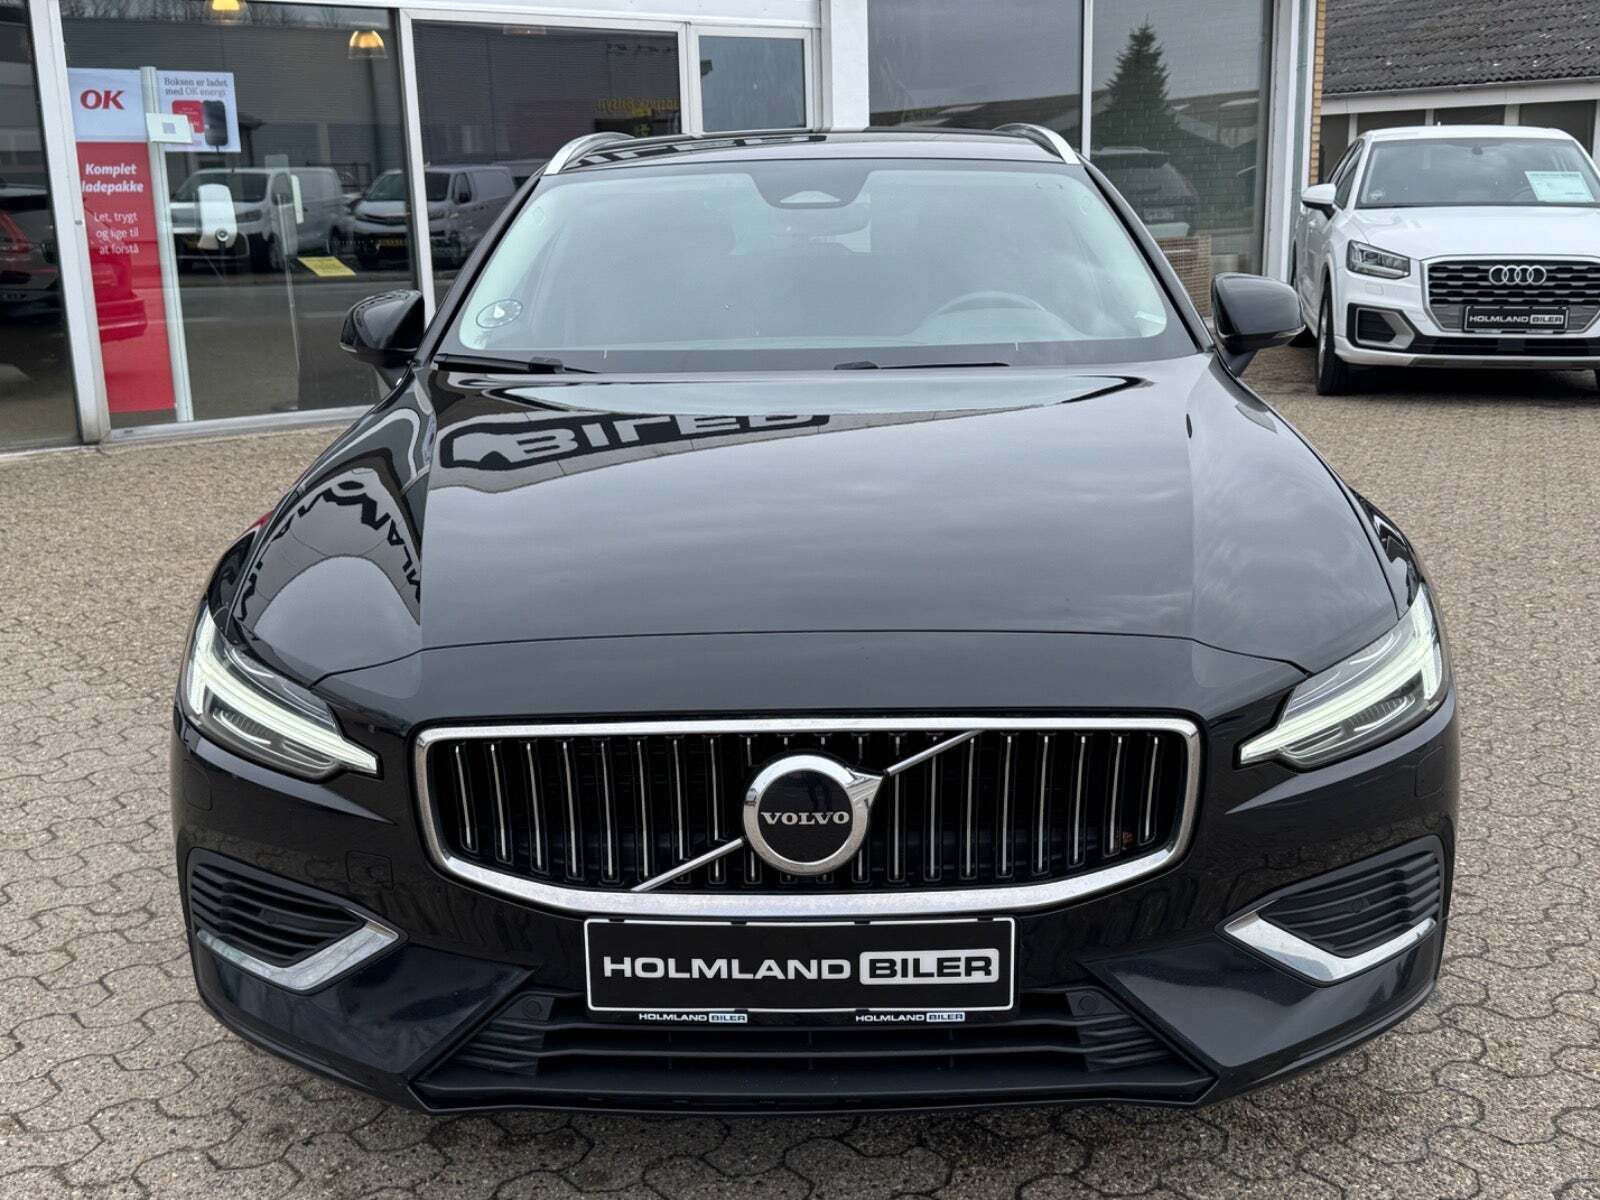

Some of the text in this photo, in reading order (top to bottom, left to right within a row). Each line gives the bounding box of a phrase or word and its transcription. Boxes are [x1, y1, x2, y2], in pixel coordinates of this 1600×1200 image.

[164, 77, 228, 88] Boksen er ladet
[165, 87, 184, 96] med
[185, 87, 199, 96] OK
[80, 89, 125, 110] OK
[85, 163, 138, 179] Komplet
[82, 180, 144, 196] ladepakke
[94, 212, 138, 224] Let, trygt
[96, 230, 110, 241] og
[130, 227, 139, 238] til
[99, 243, 139, 256] at forstå
[1469, 314, 1563, 324] HOLMLAND BILER
[760, 810, 850, 826] VOLVO
[603, 954, 995, 981] HOLMLAND BILER
[639, 1012, 747, 1023] HOLMLAND BILER
[855, 1012, 965, 1022] HOLMLAND BILER
